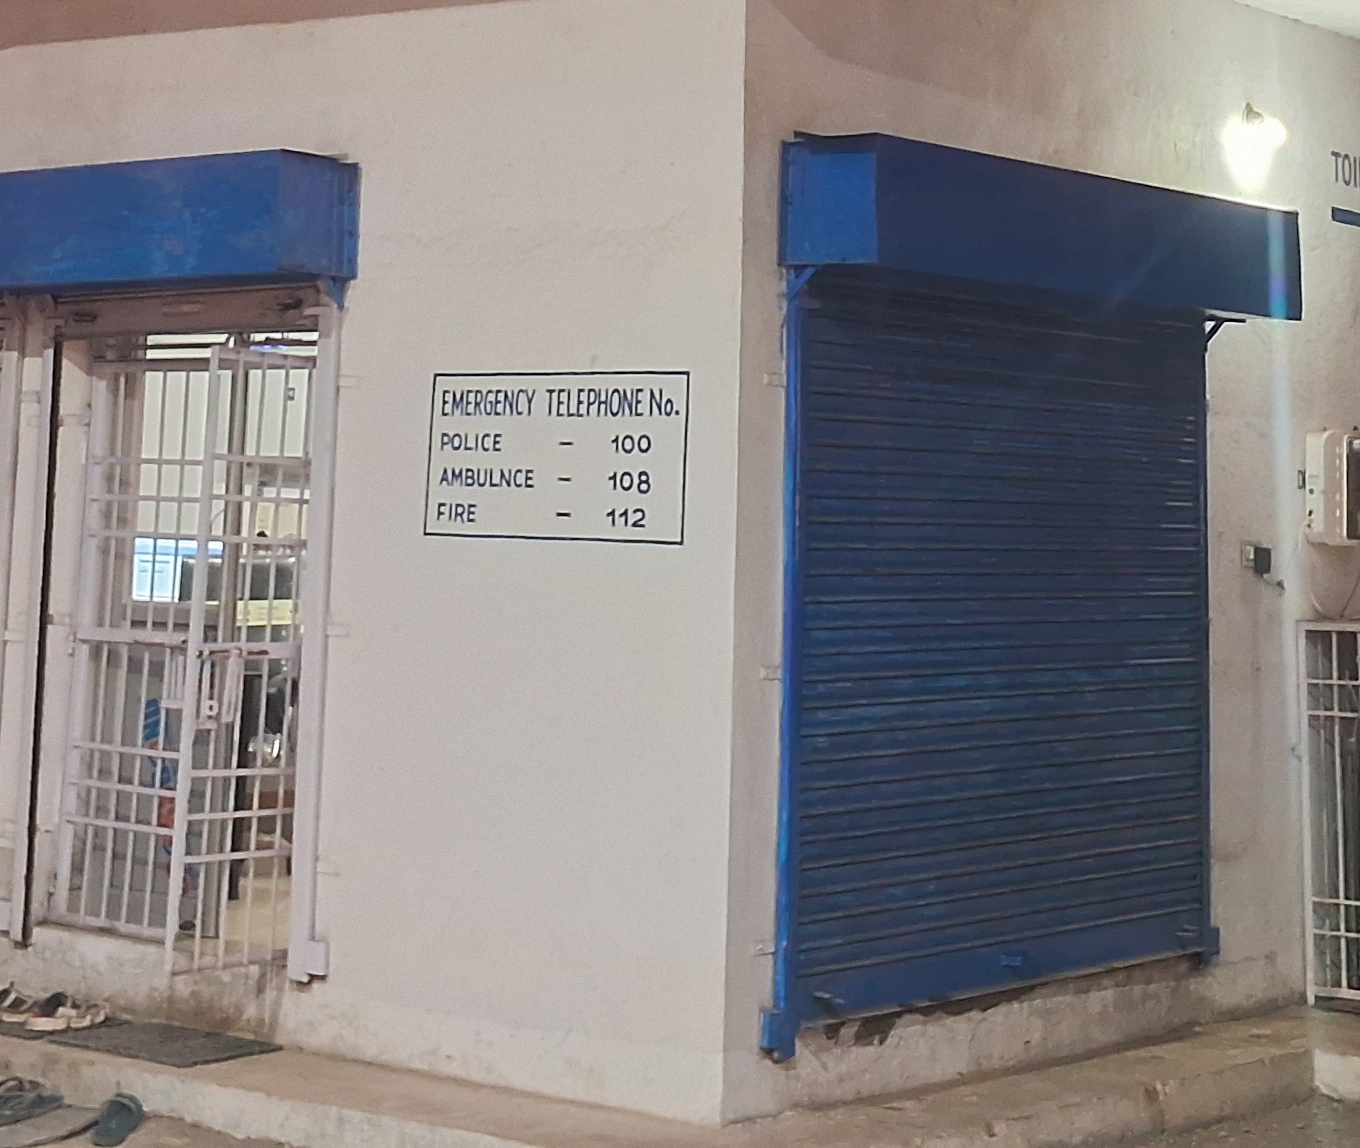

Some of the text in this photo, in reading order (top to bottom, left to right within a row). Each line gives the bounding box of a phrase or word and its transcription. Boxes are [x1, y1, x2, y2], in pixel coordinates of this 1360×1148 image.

[441, 388, 680, 417] EMERGENCY TELEPHONE No.
[440, 432, 502, 452] POLICE
[611, 434, 651, 454] 100
[439, 467, 534, 489] AMBULNCE
[608, 471, 651, 494] 108
[437, 503, 477, 523] FIRE
[606, 508, 646, 528] 112
